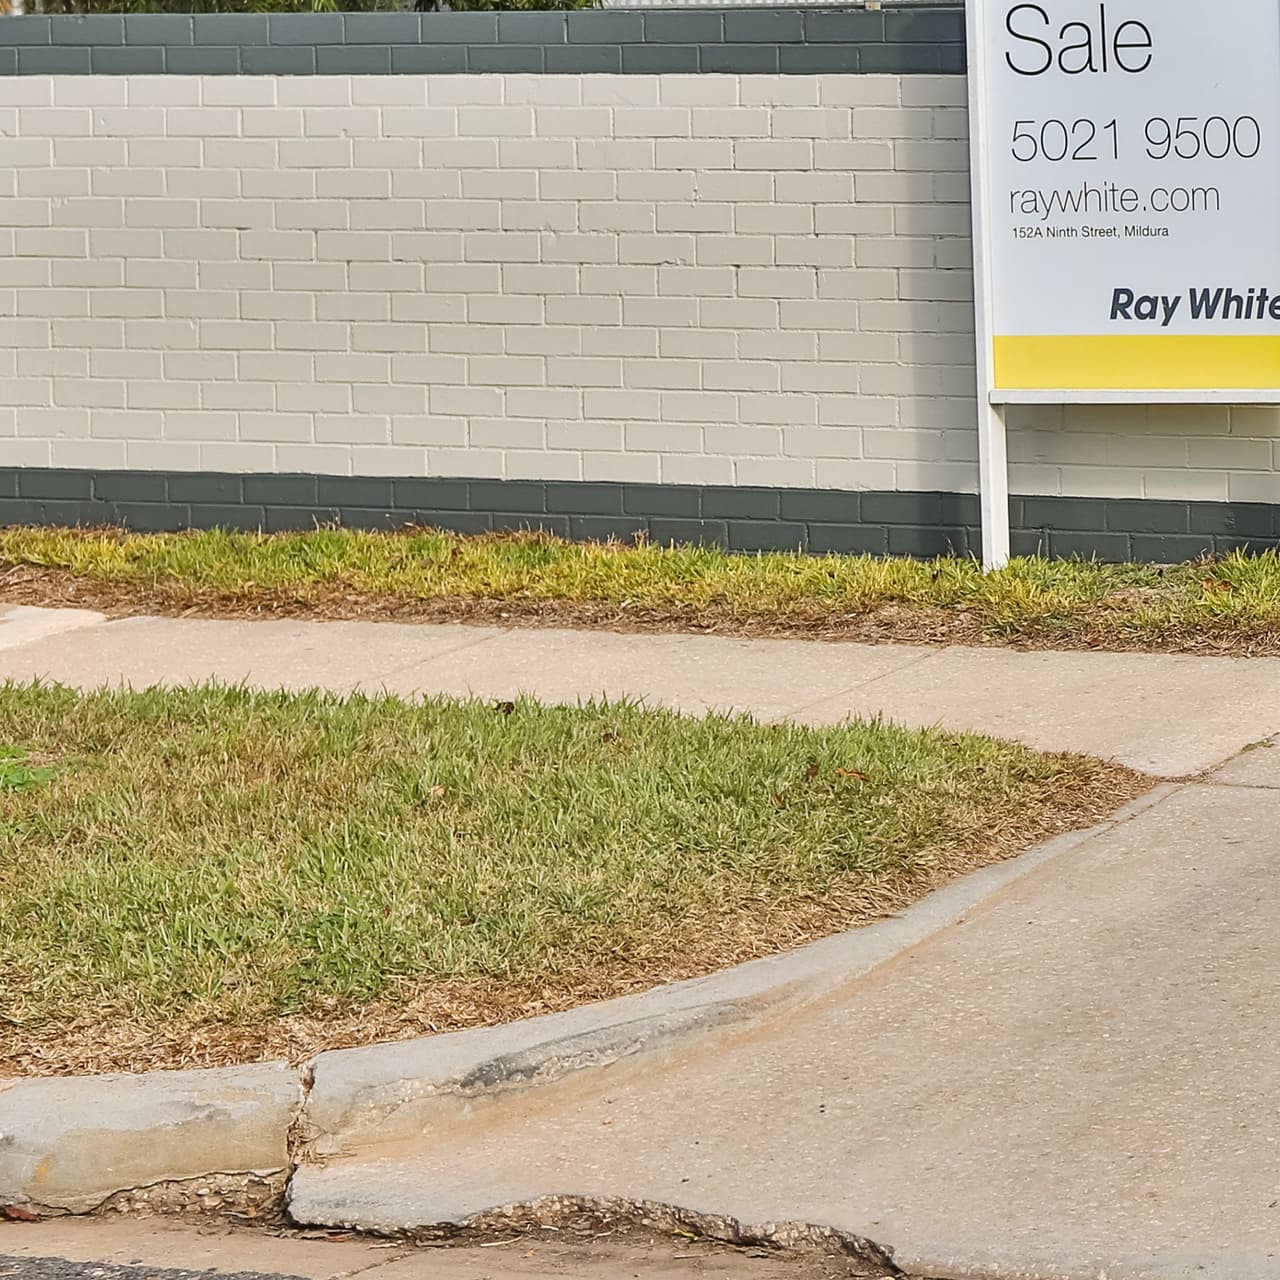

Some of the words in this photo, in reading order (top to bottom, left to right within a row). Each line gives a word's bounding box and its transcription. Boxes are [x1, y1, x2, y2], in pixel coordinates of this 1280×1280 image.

[1004, 2, 1153, 76] Sale
[1010, 118, 1120, 162] 5021
[1144, 115, 1262, 160] 9500
[1008, 180, 1221, 221] raywhite.com
[1011, 226, 1044, 239] 152A
[1046, 225, 1079, 239] Ninth
[1081, 225, 1122, 239] Street,
[1124, 224, 1170, 238] Mildura
[1109, 287, 1182, 327] Ray
